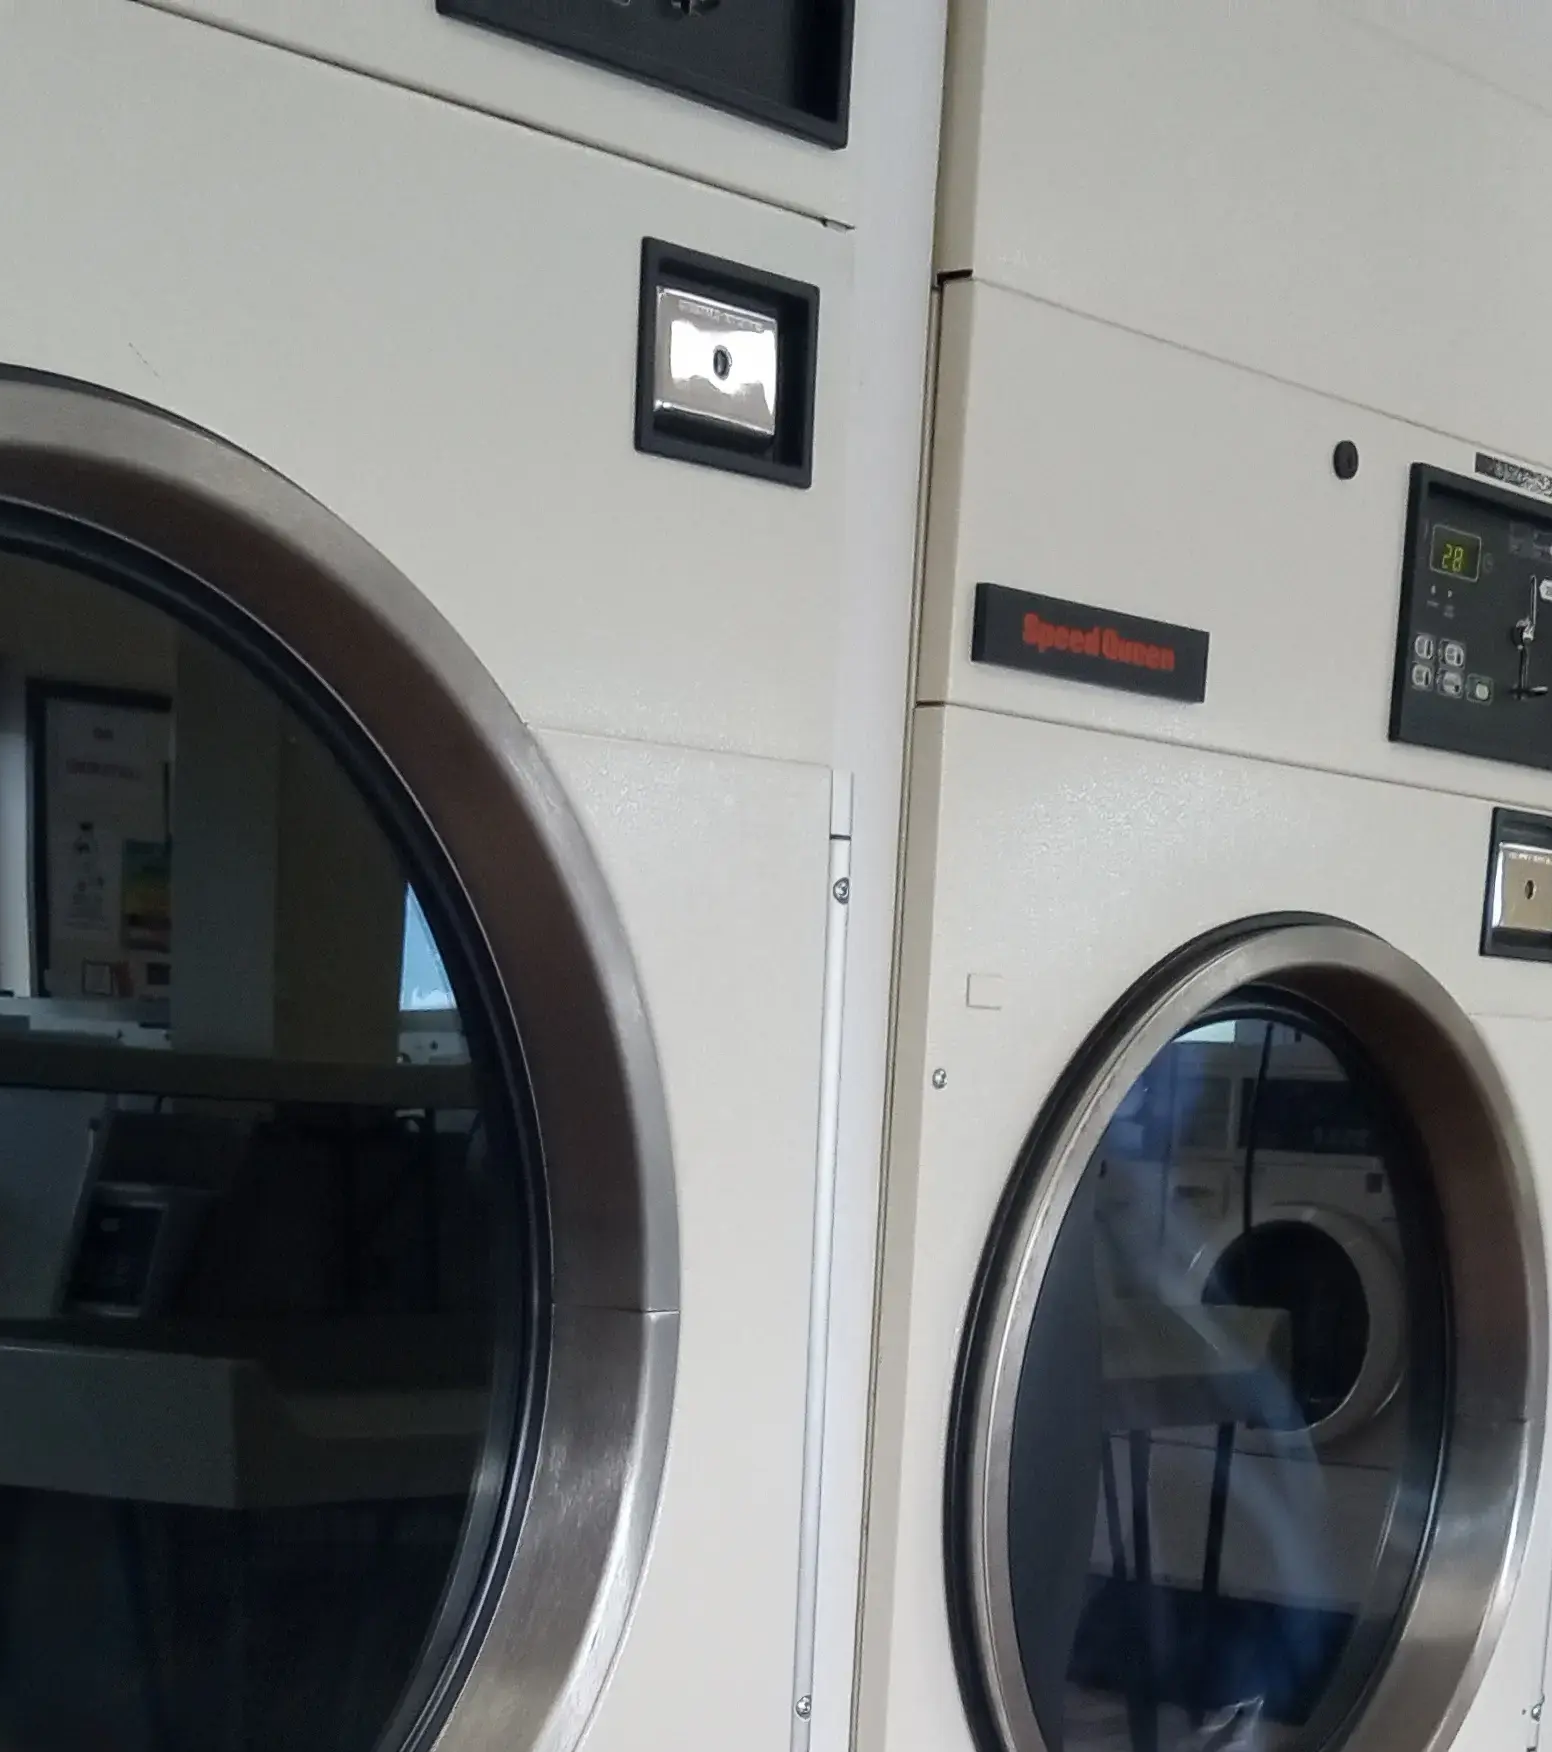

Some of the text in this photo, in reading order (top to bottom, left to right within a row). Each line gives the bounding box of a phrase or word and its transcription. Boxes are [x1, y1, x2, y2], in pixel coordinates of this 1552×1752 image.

[1441, 543, 1464, 572] 28
[1022, 612, 1175, 672] Speed Queen
